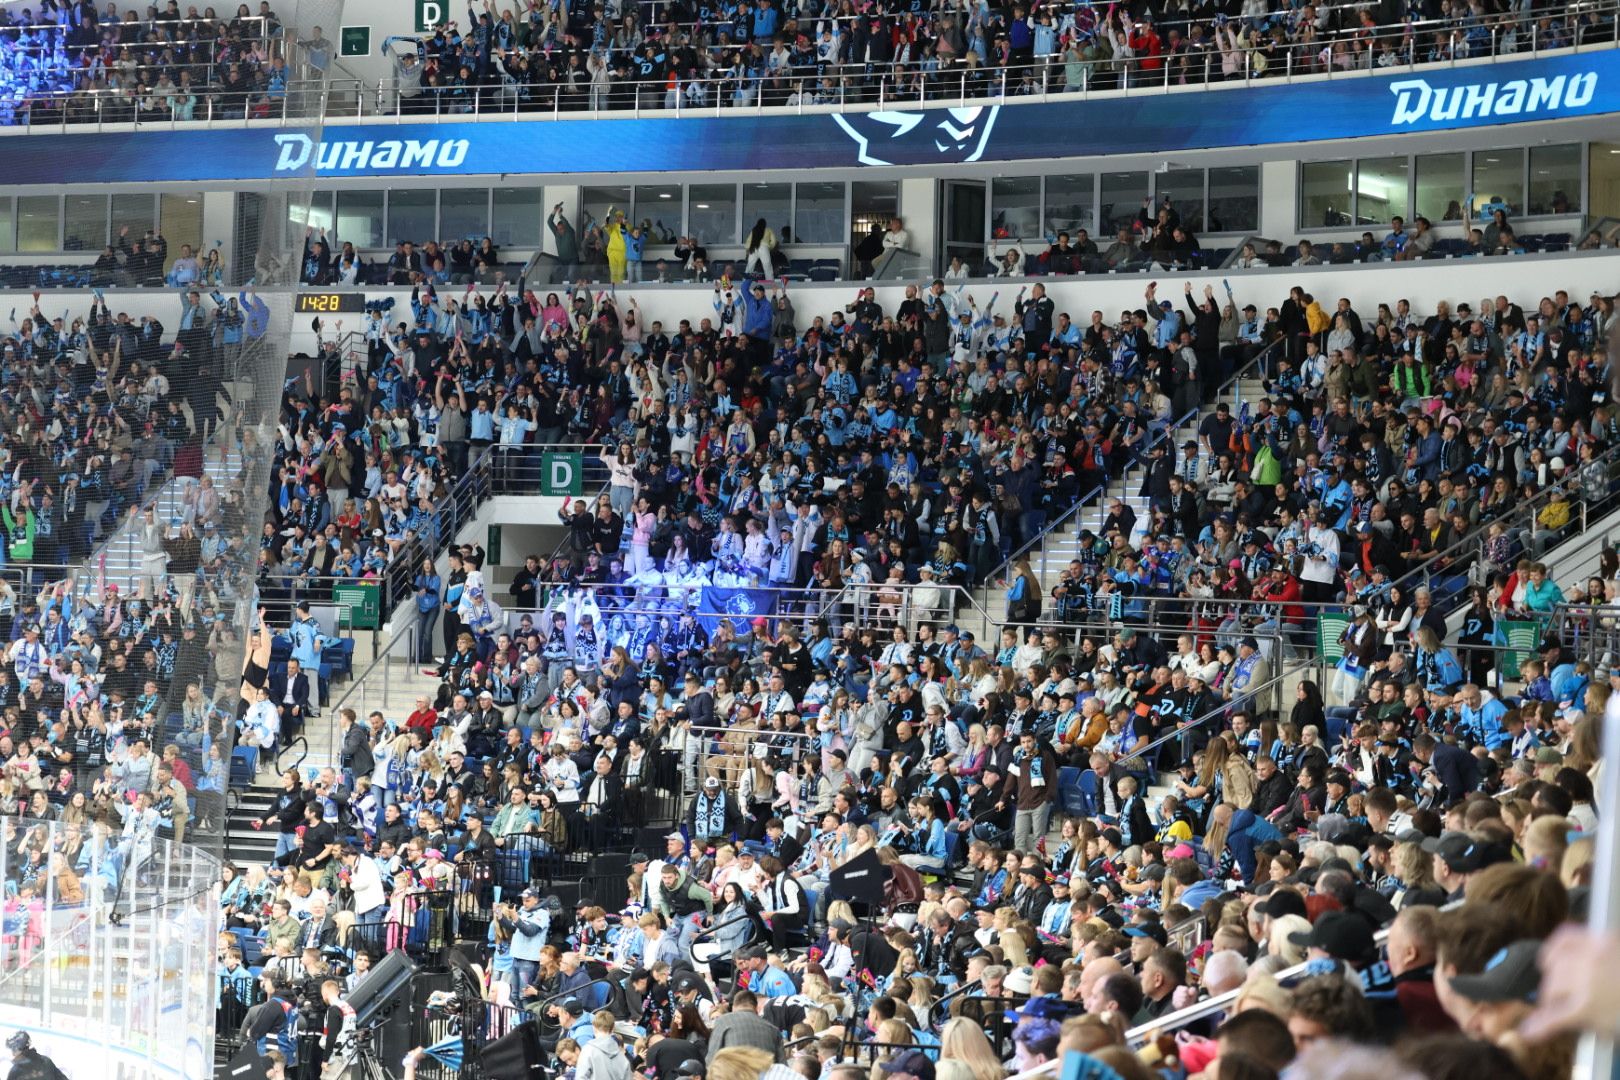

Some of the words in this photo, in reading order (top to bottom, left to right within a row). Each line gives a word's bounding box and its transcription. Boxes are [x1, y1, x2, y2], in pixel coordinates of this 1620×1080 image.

[423, 2, 441, 24] D
[302, 295, 339, 311] 14:28
[551, 461, 572, 488] D
